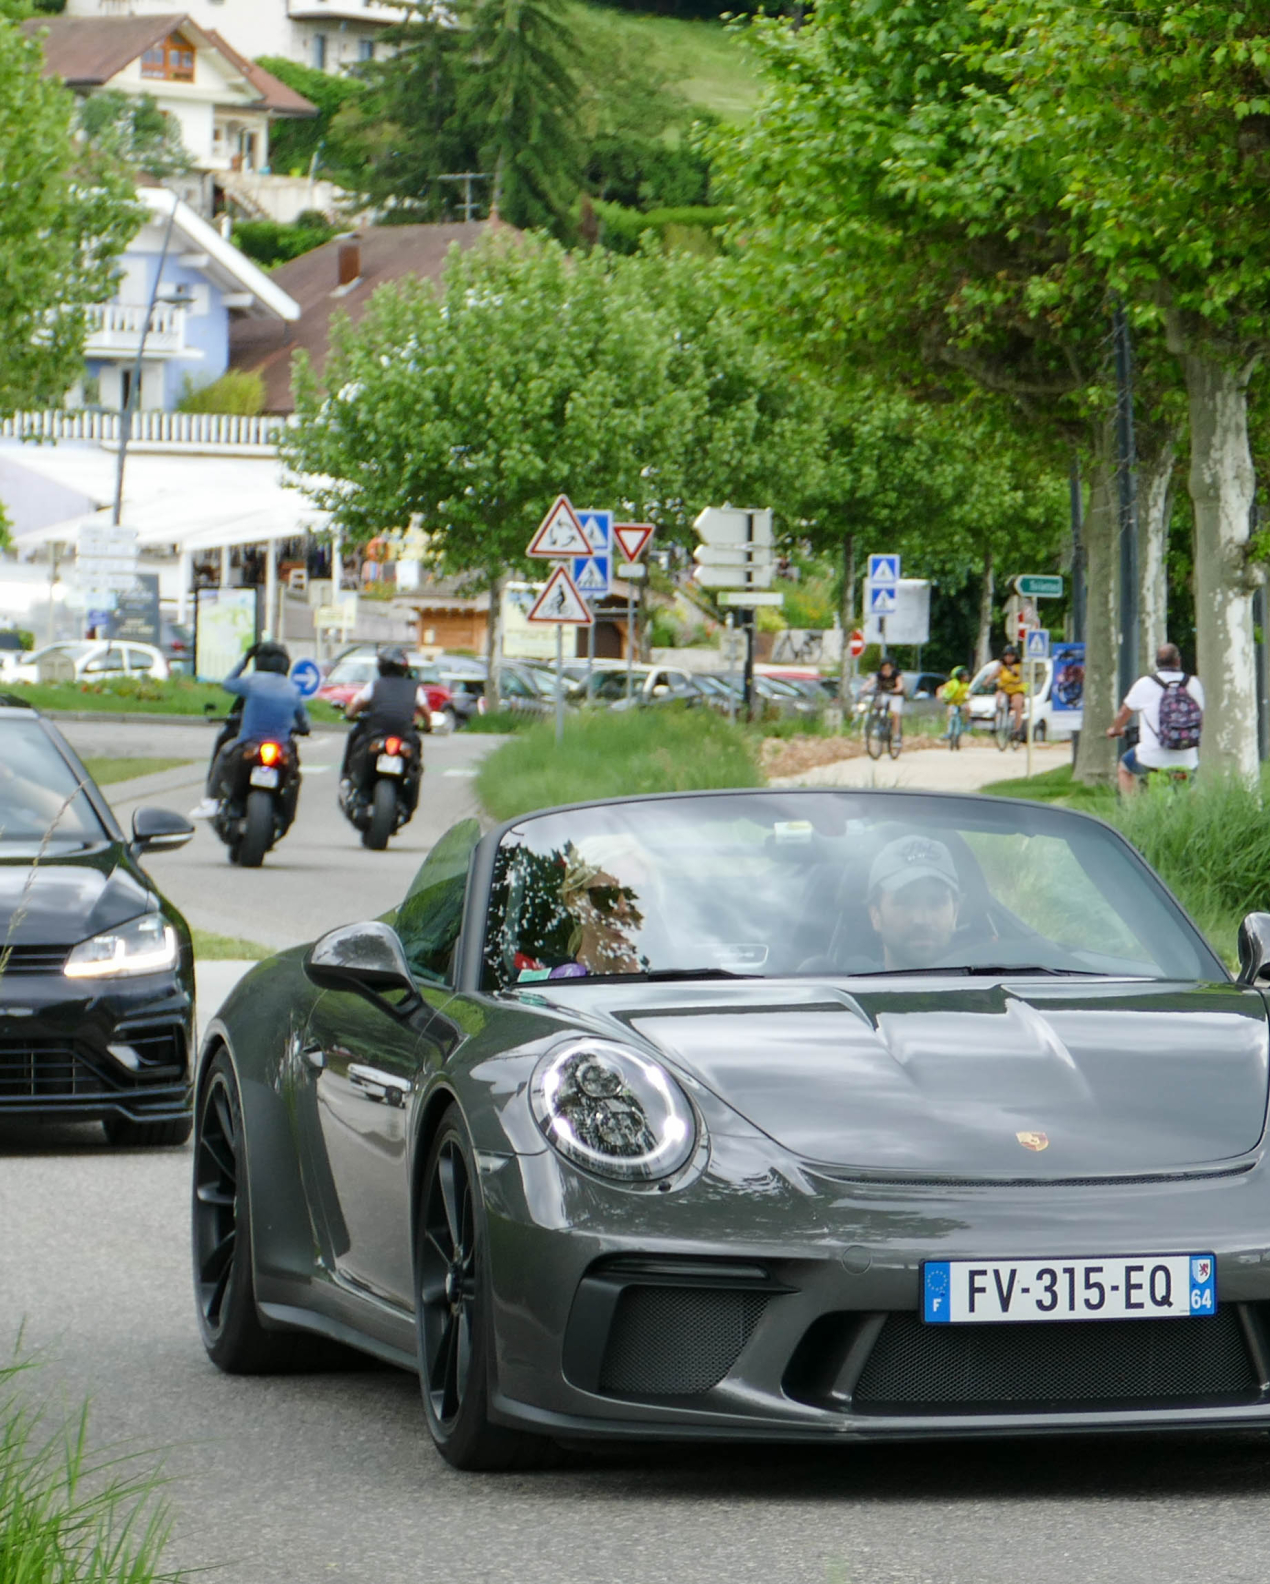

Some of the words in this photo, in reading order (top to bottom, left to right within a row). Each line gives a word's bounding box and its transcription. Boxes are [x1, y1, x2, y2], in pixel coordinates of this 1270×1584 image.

[968, 1264, 1173, 1314] FV-315-EQ
[1191, 1288, 1212, 1309] 64
[932, 1298, 942, 1312] F
